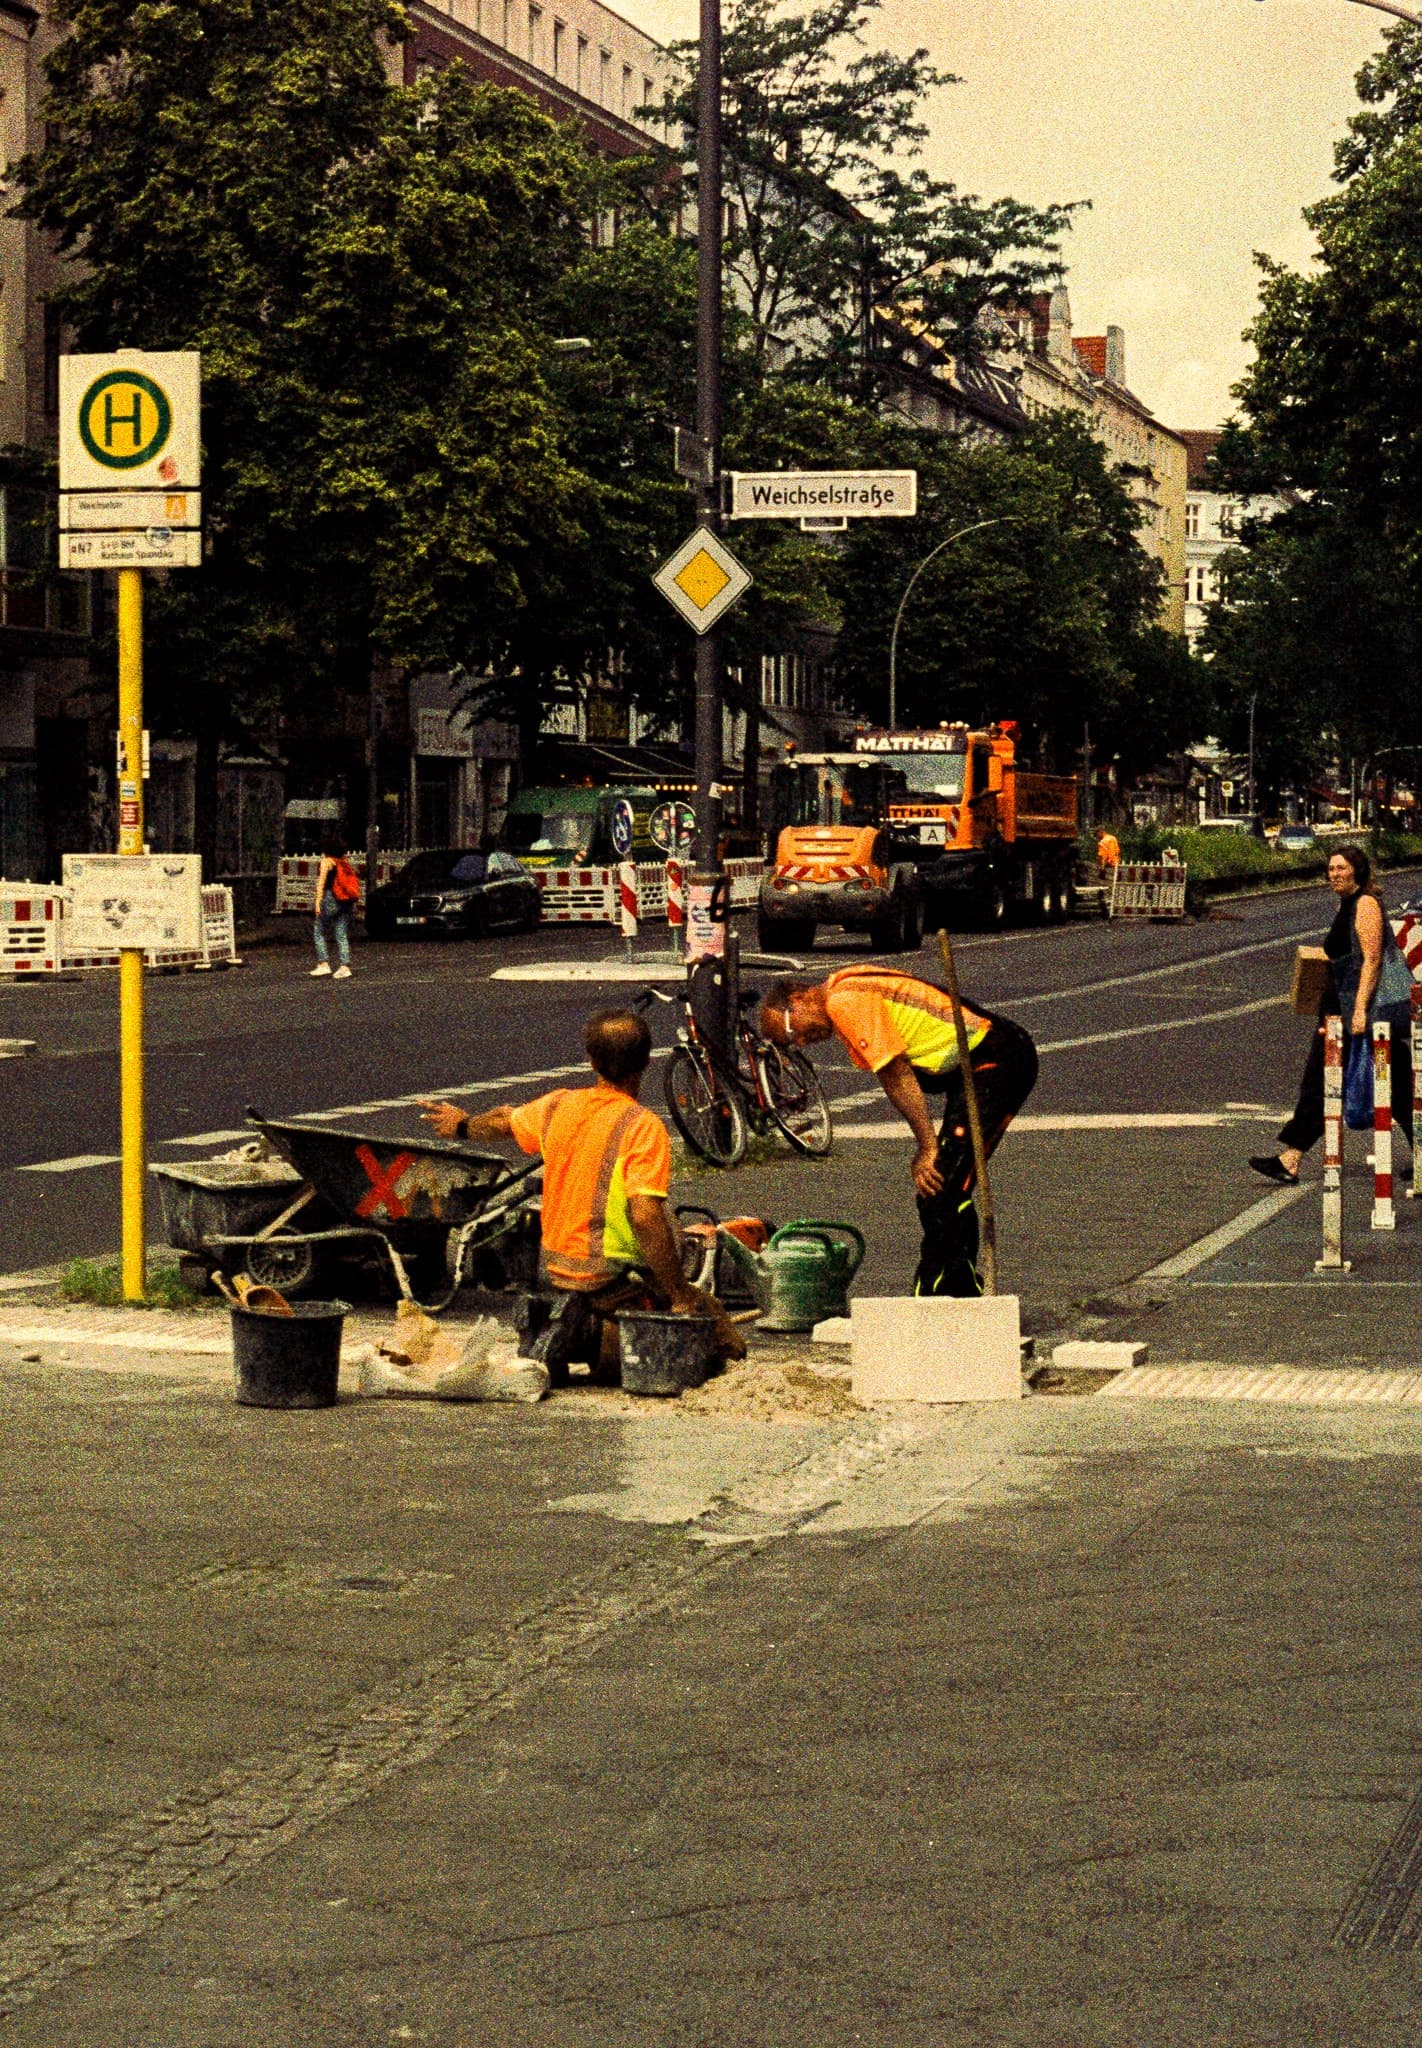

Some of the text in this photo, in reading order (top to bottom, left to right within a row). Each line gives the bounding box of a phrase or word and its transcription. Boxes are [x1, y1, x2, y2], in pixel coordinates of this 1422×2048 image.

[104, 392, 141, 447] H
[752, 485, 894, 508] Weichselstraße
[78, 541, 92, 554] N7
[927, 829, 939, 842] A
